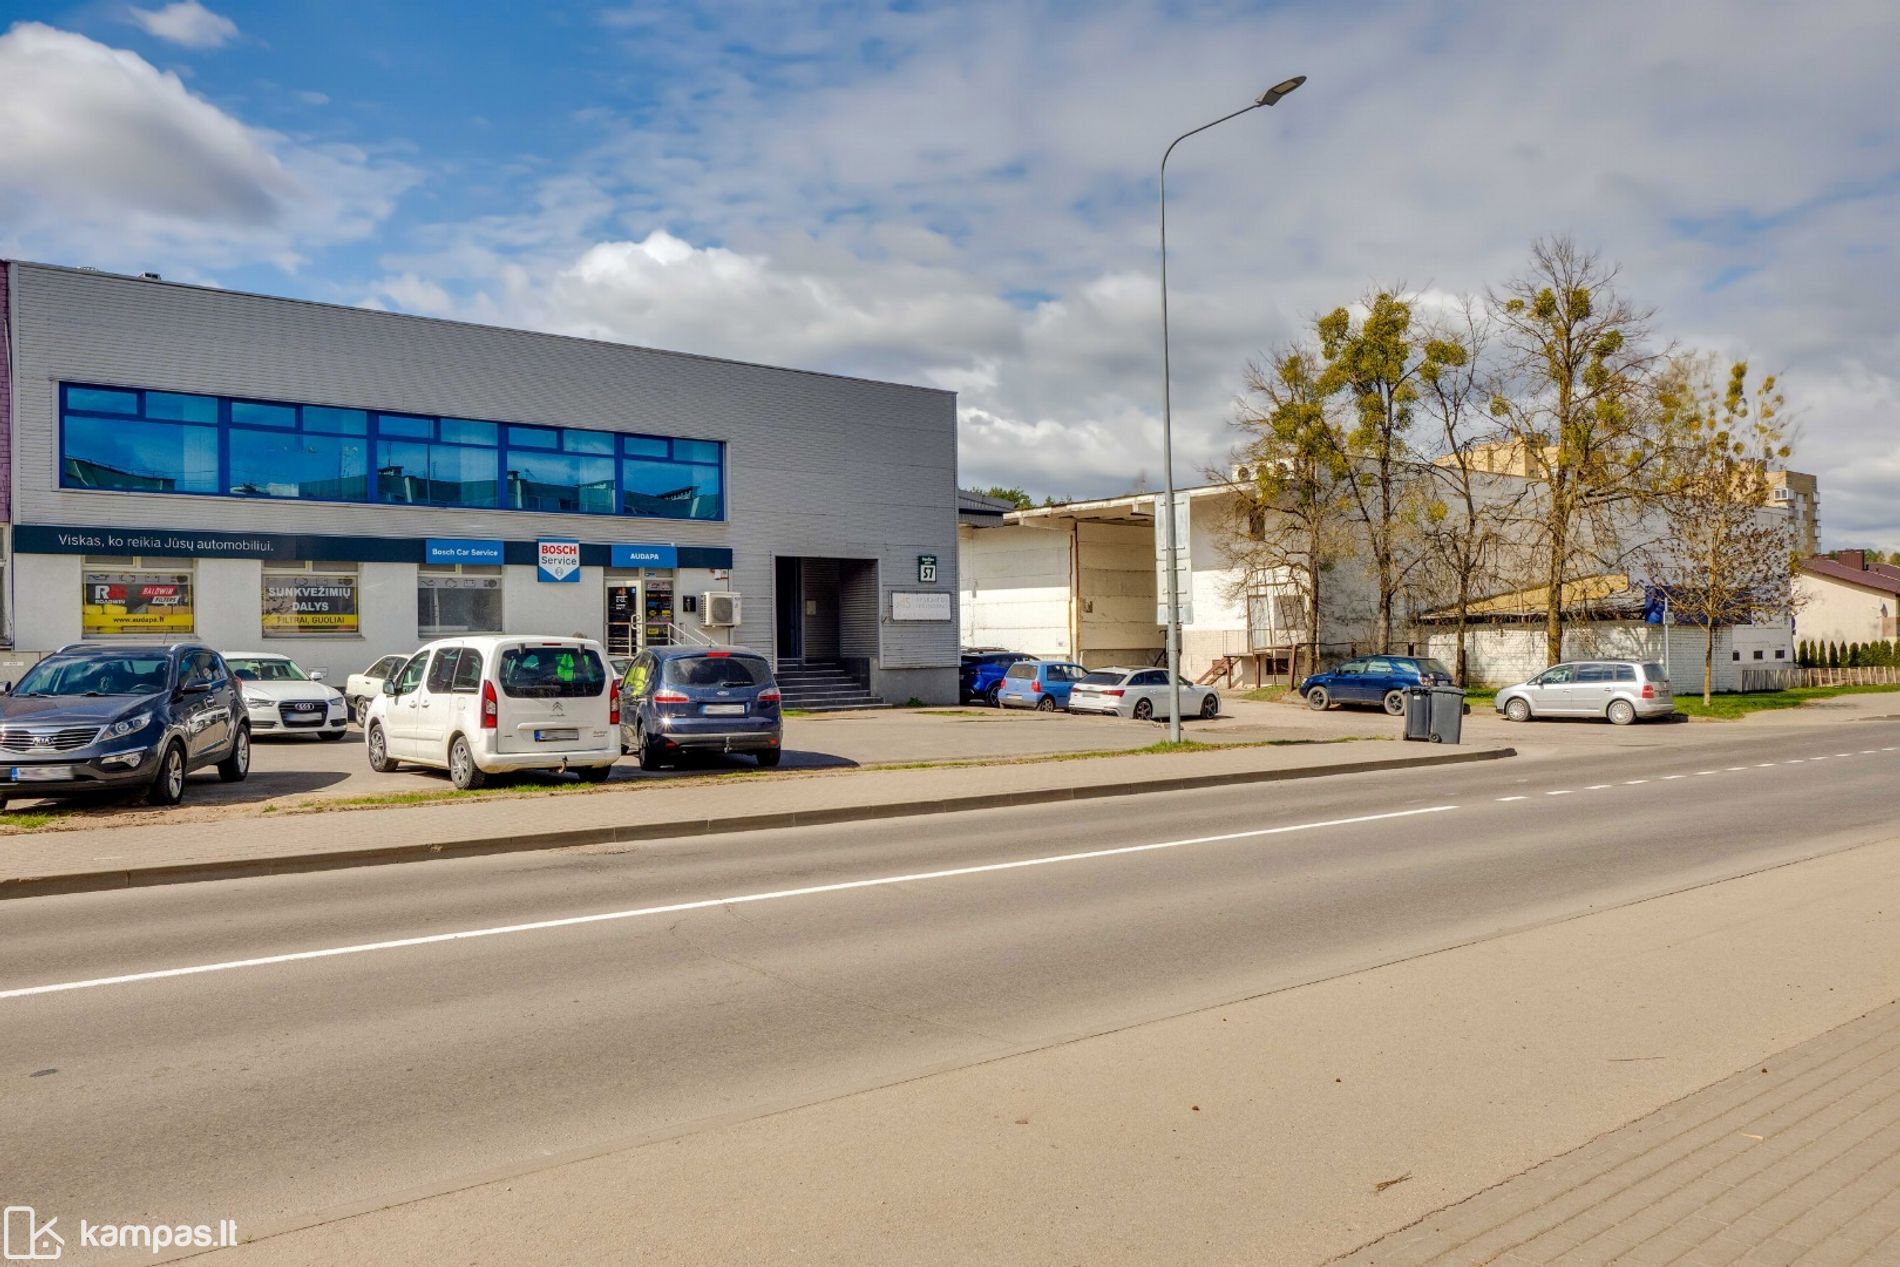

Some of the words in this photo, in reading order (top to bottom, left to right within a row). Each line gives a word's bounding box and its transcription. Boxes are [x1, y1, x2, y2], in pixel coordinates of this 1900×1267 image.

[58, 534, 105, 548] Viskas,
[108, 535, 124, 547] ko
[127, 536, 162, 548] reikia
[197, 539, 274, 552] automobiliui.
[432, 548, 455, 556] Bosch
[471, 549, 498, 557] Service
[541, 545, 577, 555] BOSCH
[541, 556, 577, 566] Service
[292, 602, 329, 611] DALYS
[312, 616, 345, 624] GUOLIAI
